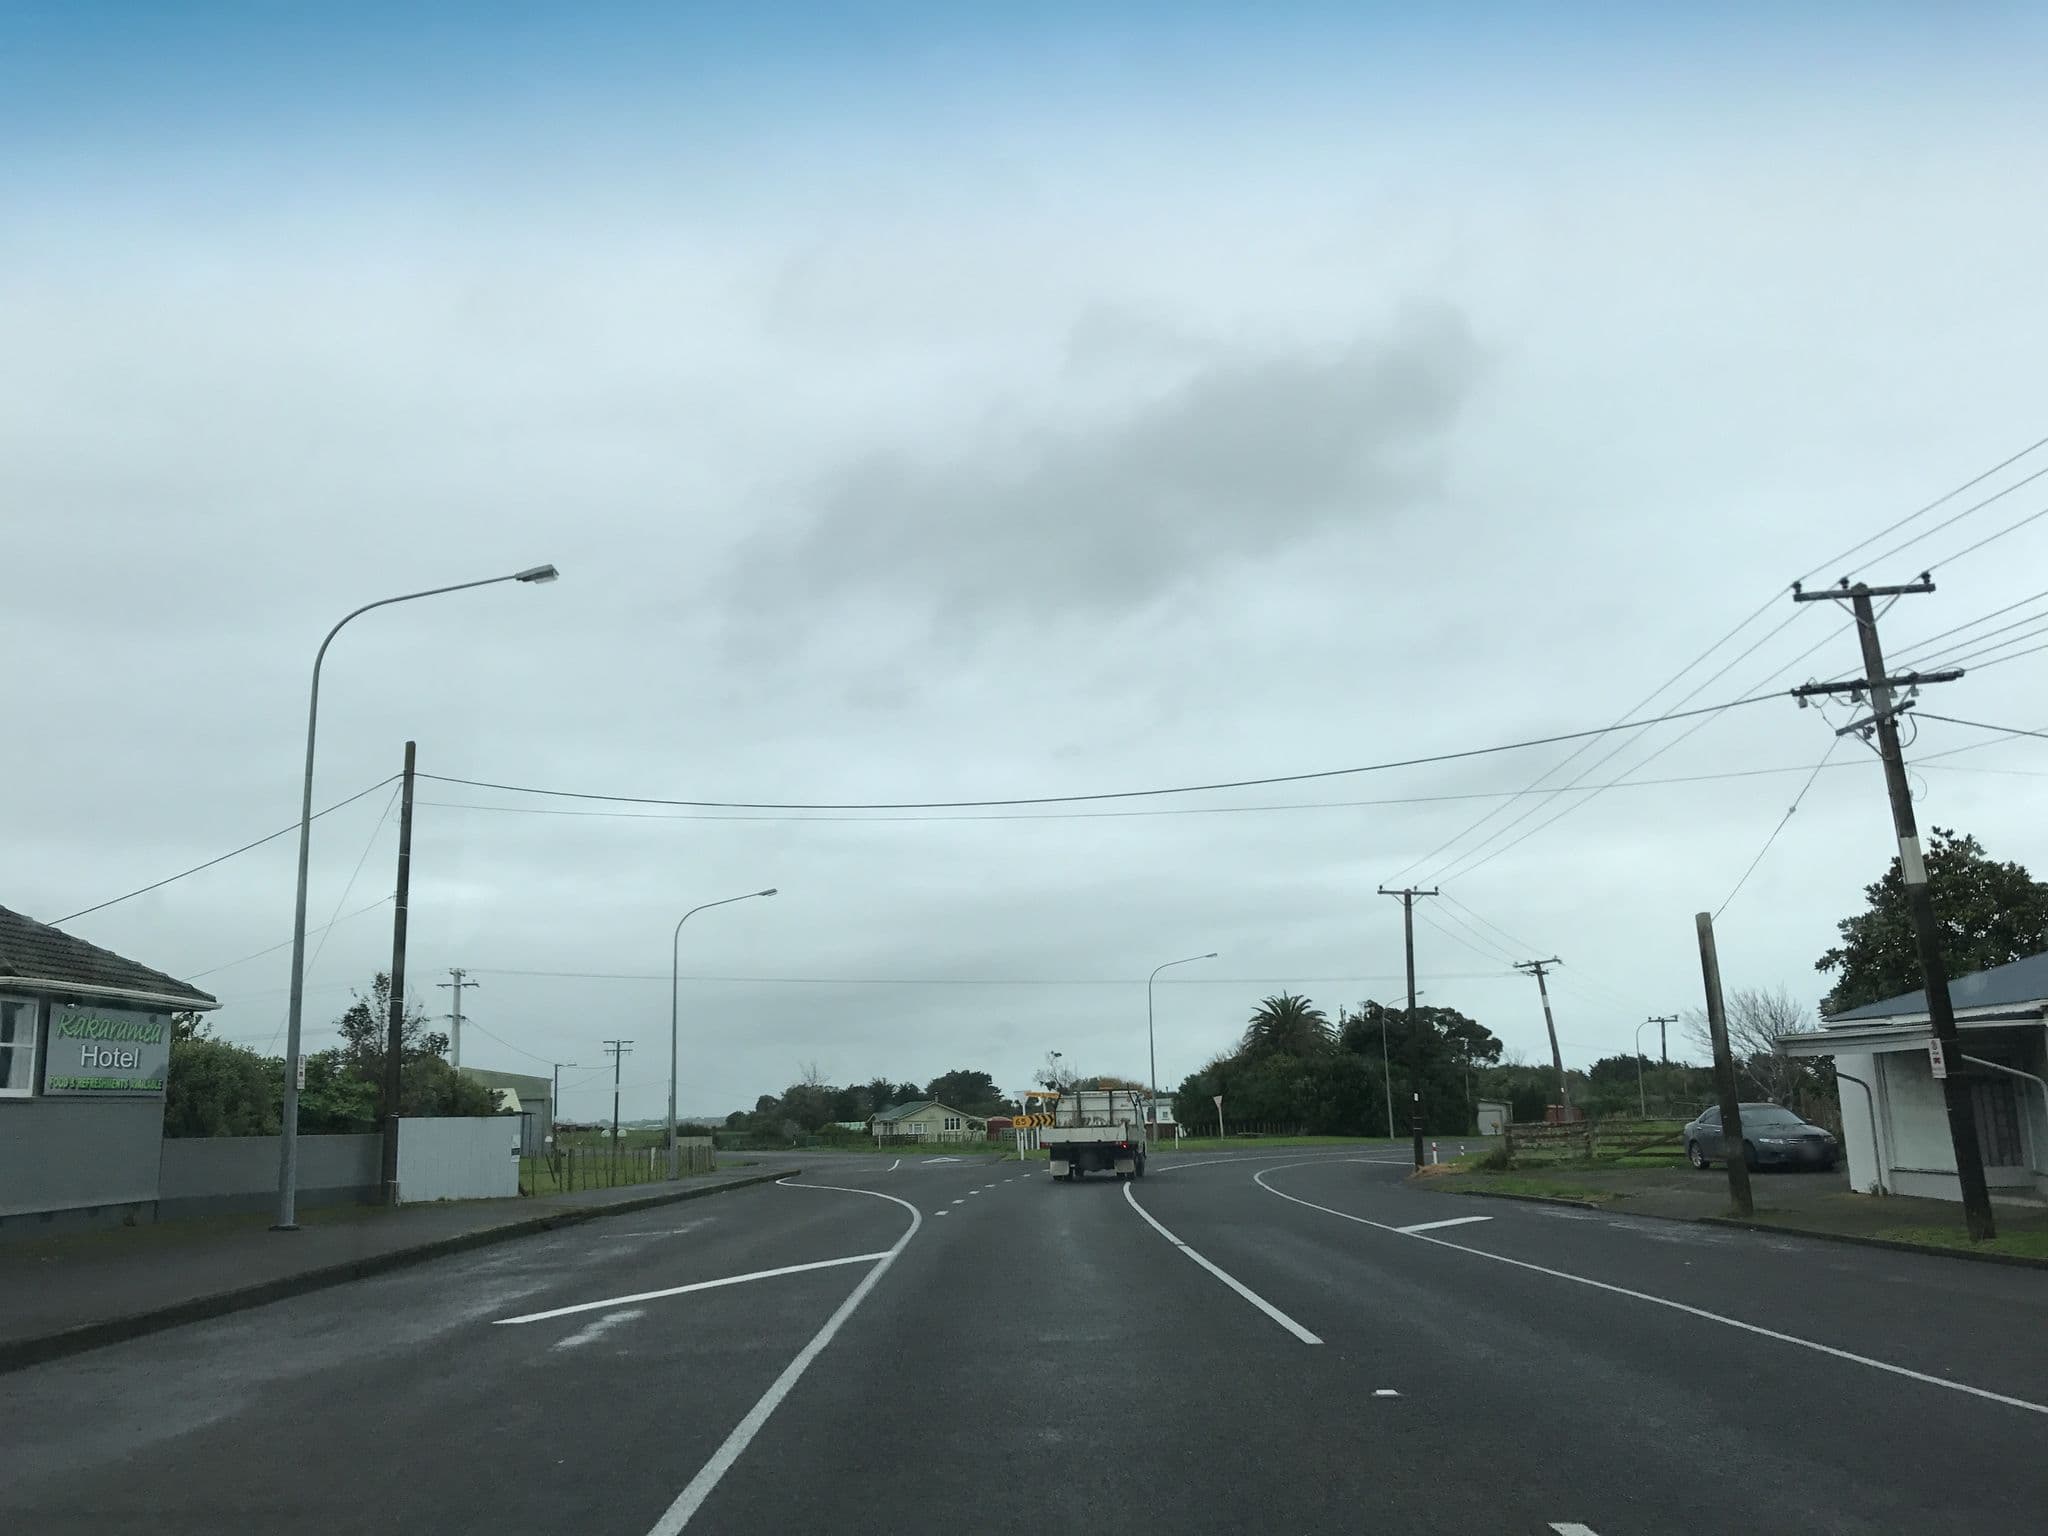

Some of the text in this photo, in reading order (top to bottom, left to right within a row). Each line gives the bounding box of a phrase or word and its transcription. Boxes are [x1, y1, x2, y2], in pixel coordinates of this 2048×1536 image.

[57, 1012, 162, 1044] Kakaramea
[81, 1044, 139, 1068] Hotel
[1015, 1118, 1026, 1126] 65
